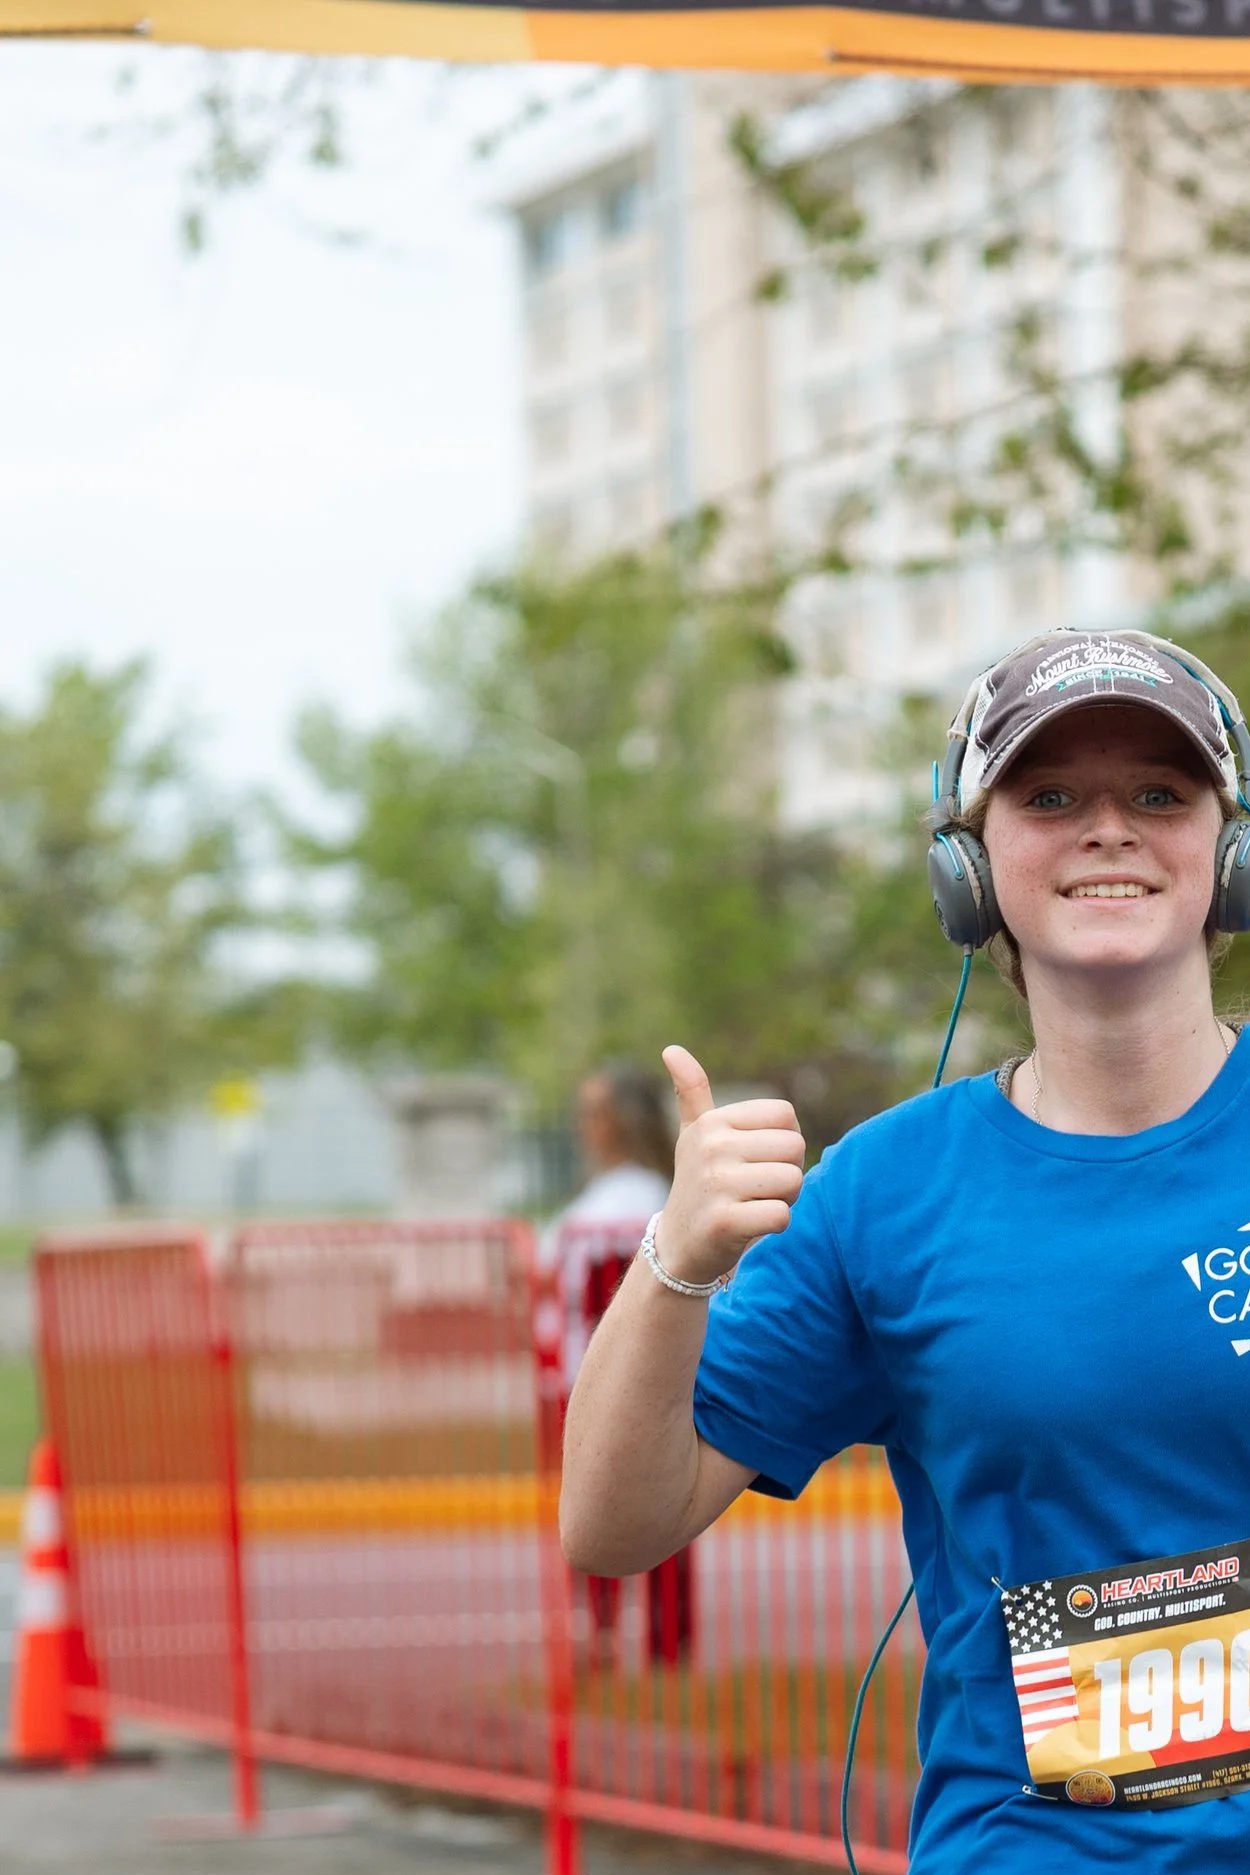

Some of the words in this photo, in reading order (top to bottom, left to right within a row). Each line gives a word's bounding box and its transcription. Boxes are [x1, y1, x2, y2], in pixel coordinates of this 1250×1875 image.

[1025, 653, 1080, 697] Mount
[1079, 647, 1174, 684] Rushmore
[1065, 669, 1104, 686] SINCE
[1101, 1556, 1240, 1603] HEARTLAND
[1103, 1599, 1127, 1609] RACING
[1147, 1588, 1185, 1601] MULTISPORT
[1187, 1578, 1231, 1593] PRODUCTIONS
[1094, 1616, 1115, 1632] GOD.
[1117, 1606, 1163, 1627] COUNTRY.
[1165, 1593, 1227, 1618] MULTISPORT.
[1180, 1783, 1201, 1793] STREET
